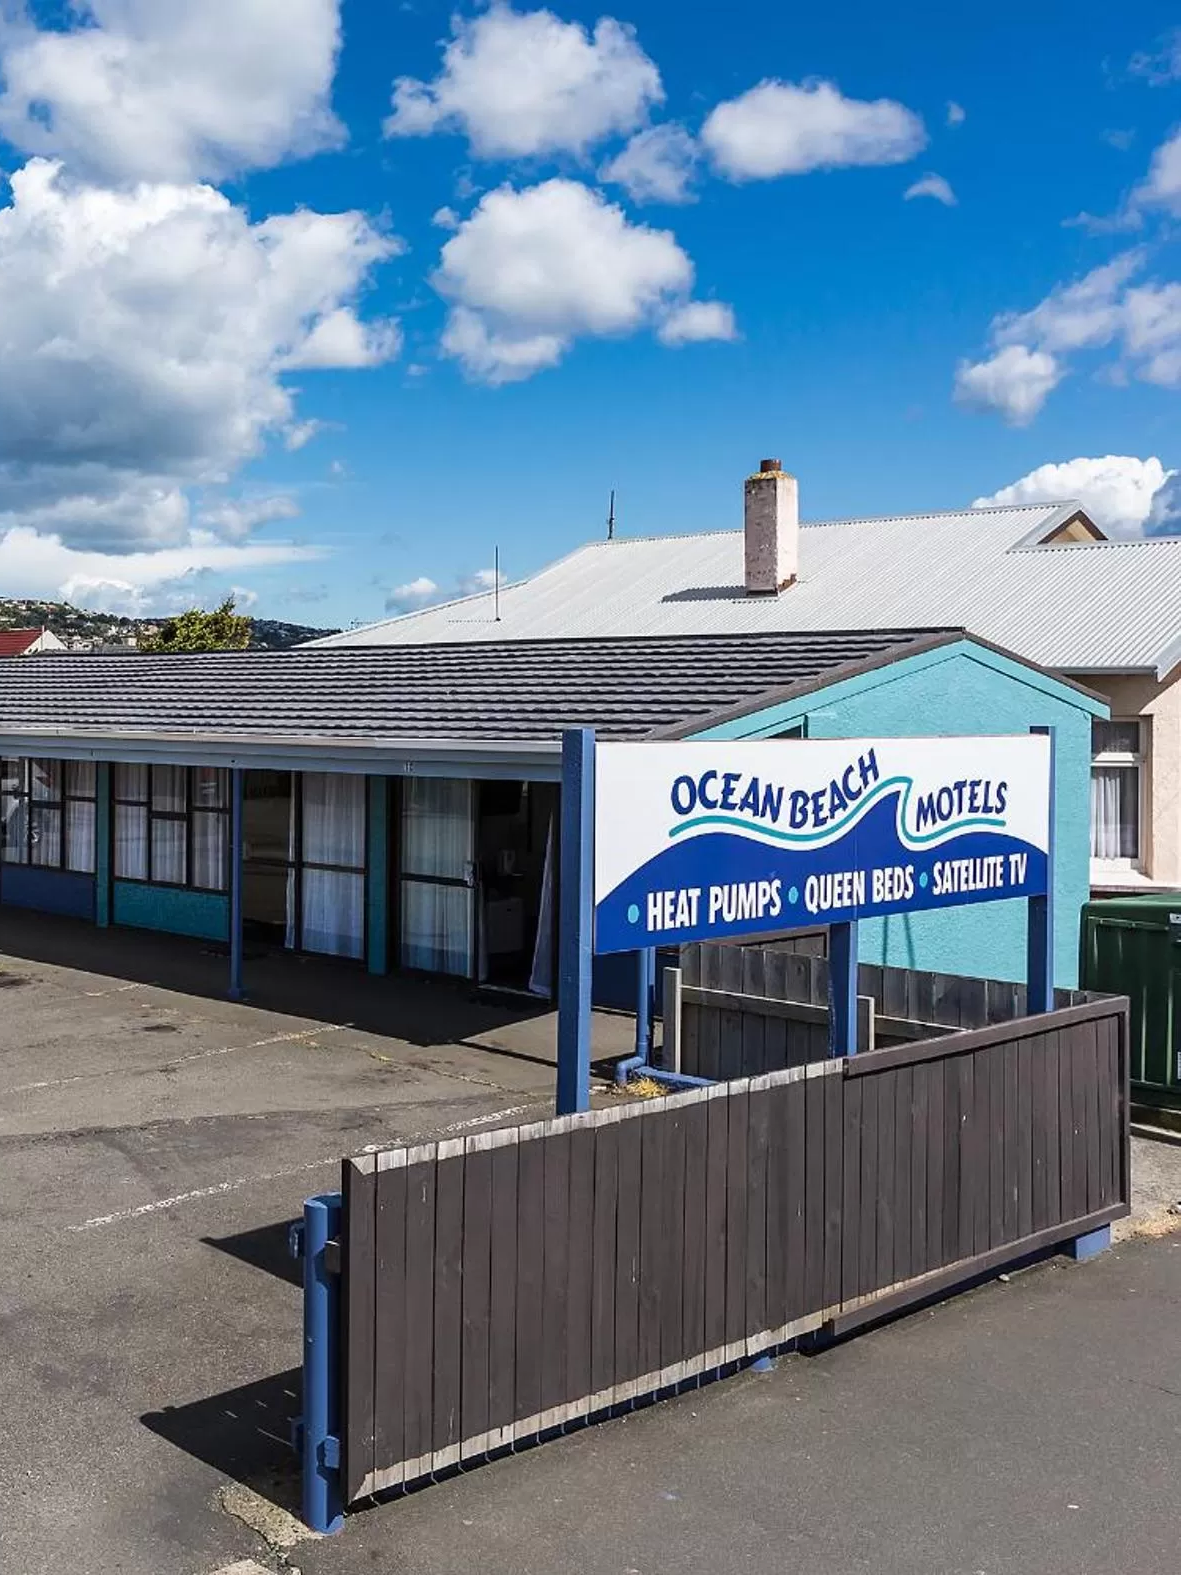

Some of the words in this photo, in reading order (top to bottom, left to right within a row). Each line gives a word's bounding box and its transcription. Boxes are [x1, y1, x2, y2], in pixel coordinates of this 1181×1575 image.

[670, 769, 785, 824] OCEAN
[788, 748, 881, 829] BEACH
[916, 779, 1008, 832] MOTELS
[646, 888, 701, 932] HEAT
[708, 878, 782, 925] PUMPS
[804, 871, 866, 914] QUEEN
[872, 864, 915, 903] BEDS
[931, 855, 1005, 897] SATELLITE
[1008, 852, 1028, 885] TV
